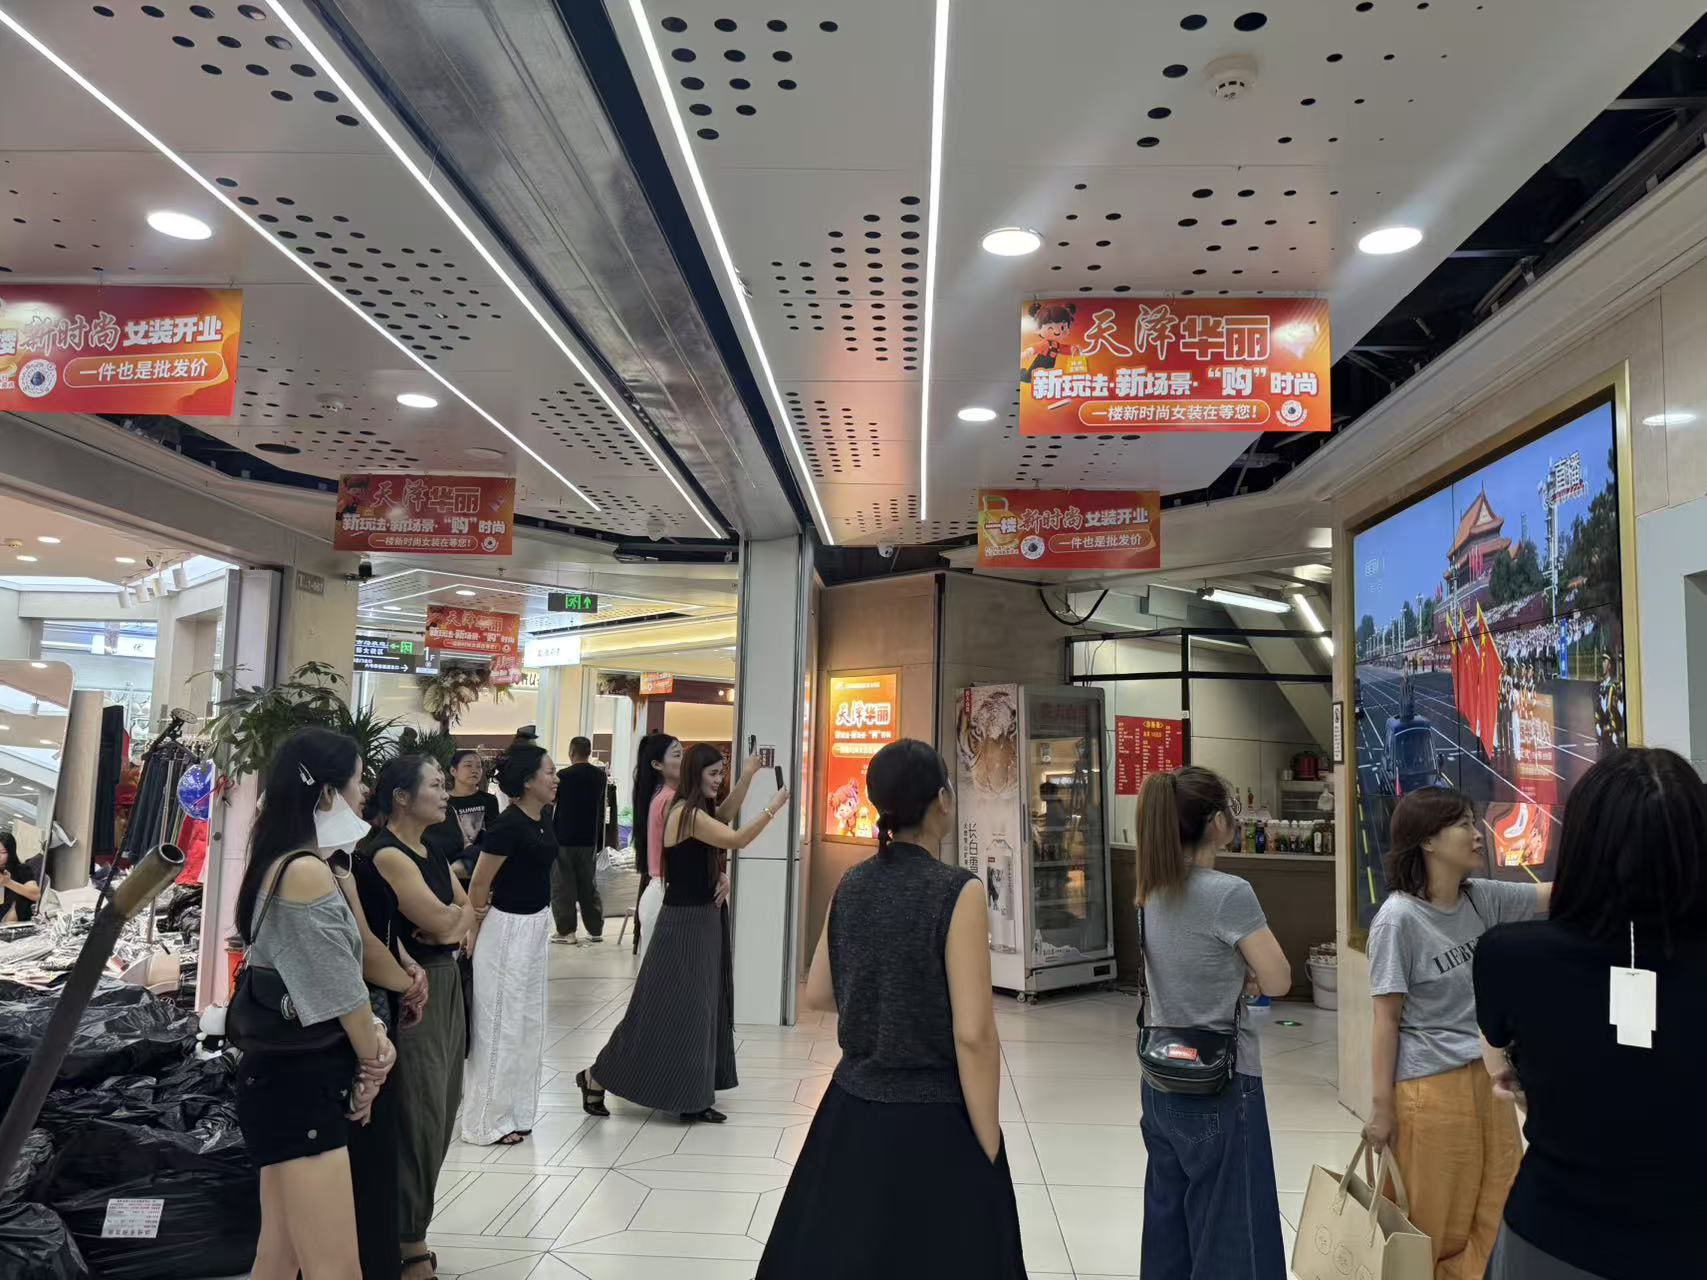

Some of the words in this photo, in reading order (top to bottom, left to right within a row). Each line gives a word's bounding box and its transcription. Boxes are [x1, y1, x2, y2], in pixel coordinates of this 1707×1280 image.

[1081, 304, 1271, 360] 天泽华丽
[80, 358, 208, 382] 一件也是批发价
[1554, 451, 1580, 491] 直播
[370, 478, 480, 514] 天泽华丽
[1058, 533, 1142, 549] 一件也是批发价
